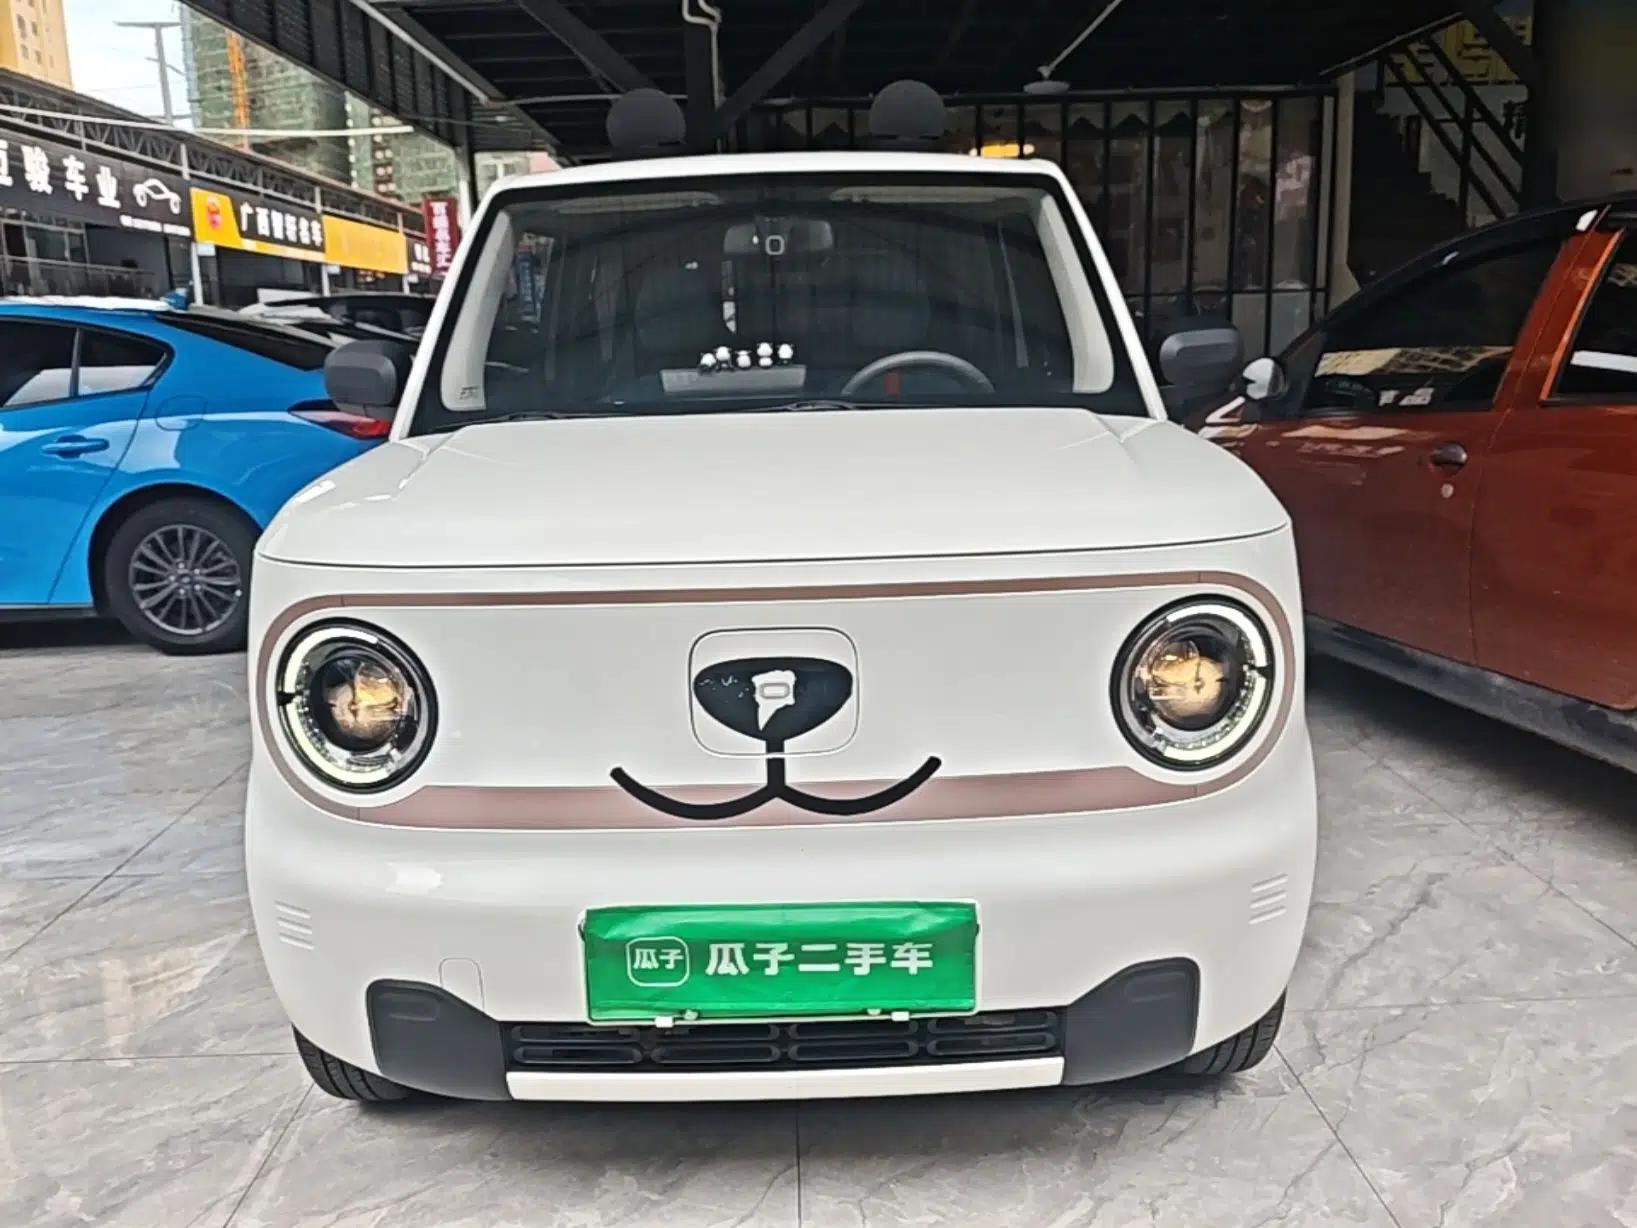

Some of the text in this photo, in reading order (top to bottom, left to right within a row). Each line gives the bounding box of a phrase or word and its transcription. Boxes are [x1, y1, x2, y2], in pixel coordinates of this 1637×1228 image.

[634, 948, 684, 971] 瓜子
[705, 942, 933, 976] 瓜子二手车
